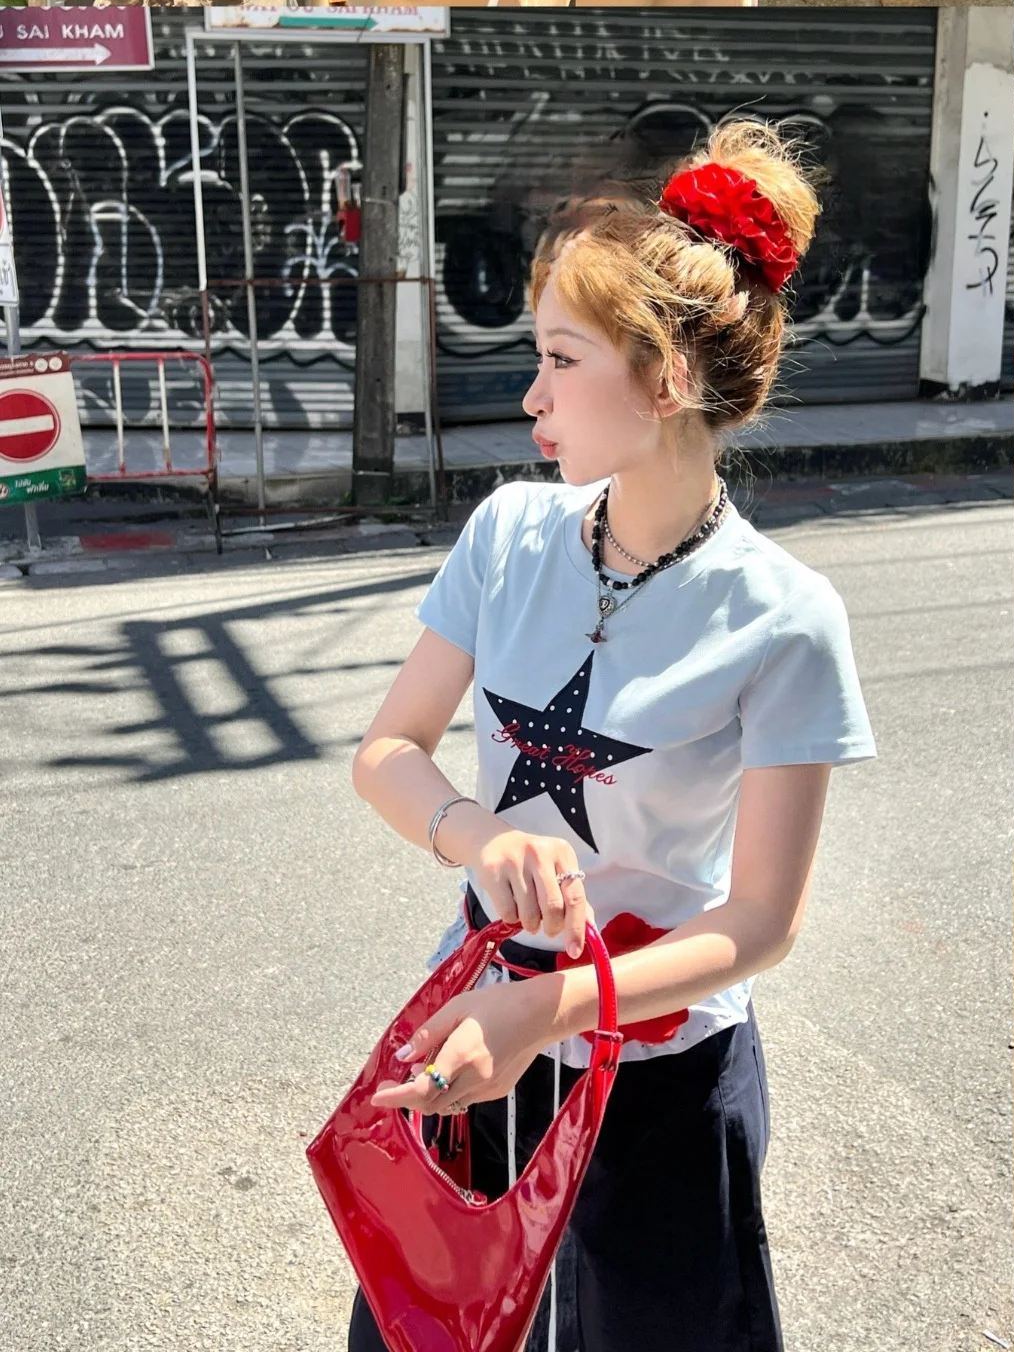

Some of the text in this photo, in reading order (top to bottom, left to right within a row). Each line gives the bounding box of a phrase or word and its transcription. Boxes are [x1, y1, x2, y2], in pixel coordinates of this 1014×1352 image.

[16, 24, 49, 39] SAI
[61, 23, 125, 39] KHAM
[491, 723, 618, 785] Great Hopes
